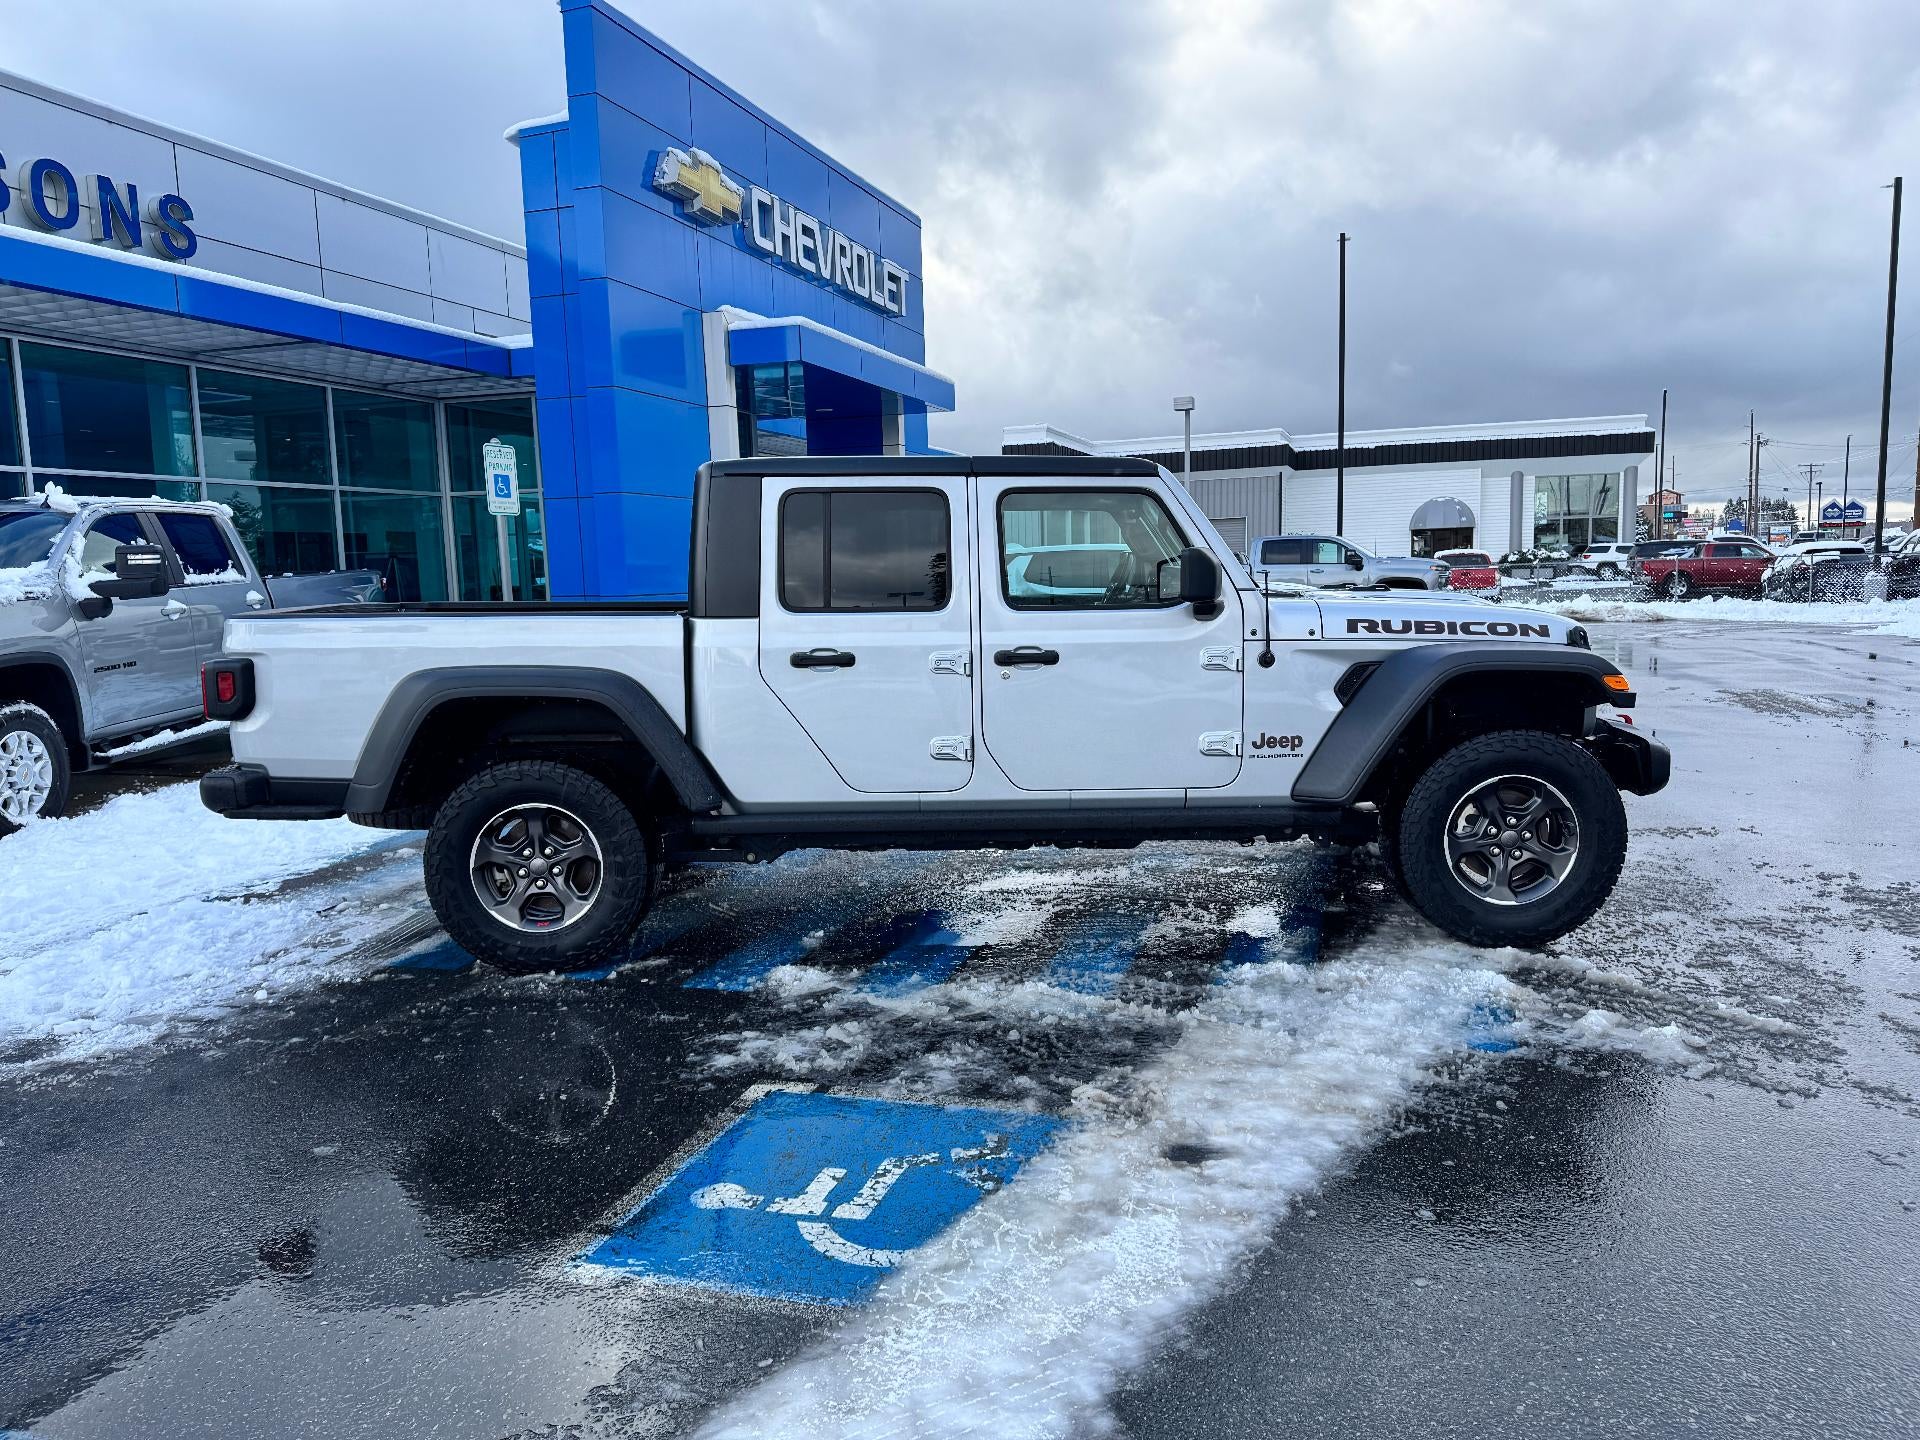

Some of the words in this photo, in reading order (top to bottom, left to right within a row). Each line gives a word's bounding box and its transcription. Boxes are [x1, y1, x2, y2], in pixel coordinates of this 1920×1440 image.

[0, 152, 197, 259] ONS
[751, 186, 909, 316] CHEVROLET
[486, 449, 513, 460] RESERVED
[489, 461, 513, 472] PARKING
[1346, 618, 1550, 638] RUBICON
[1251, 732, 1303, 751] Jeep
